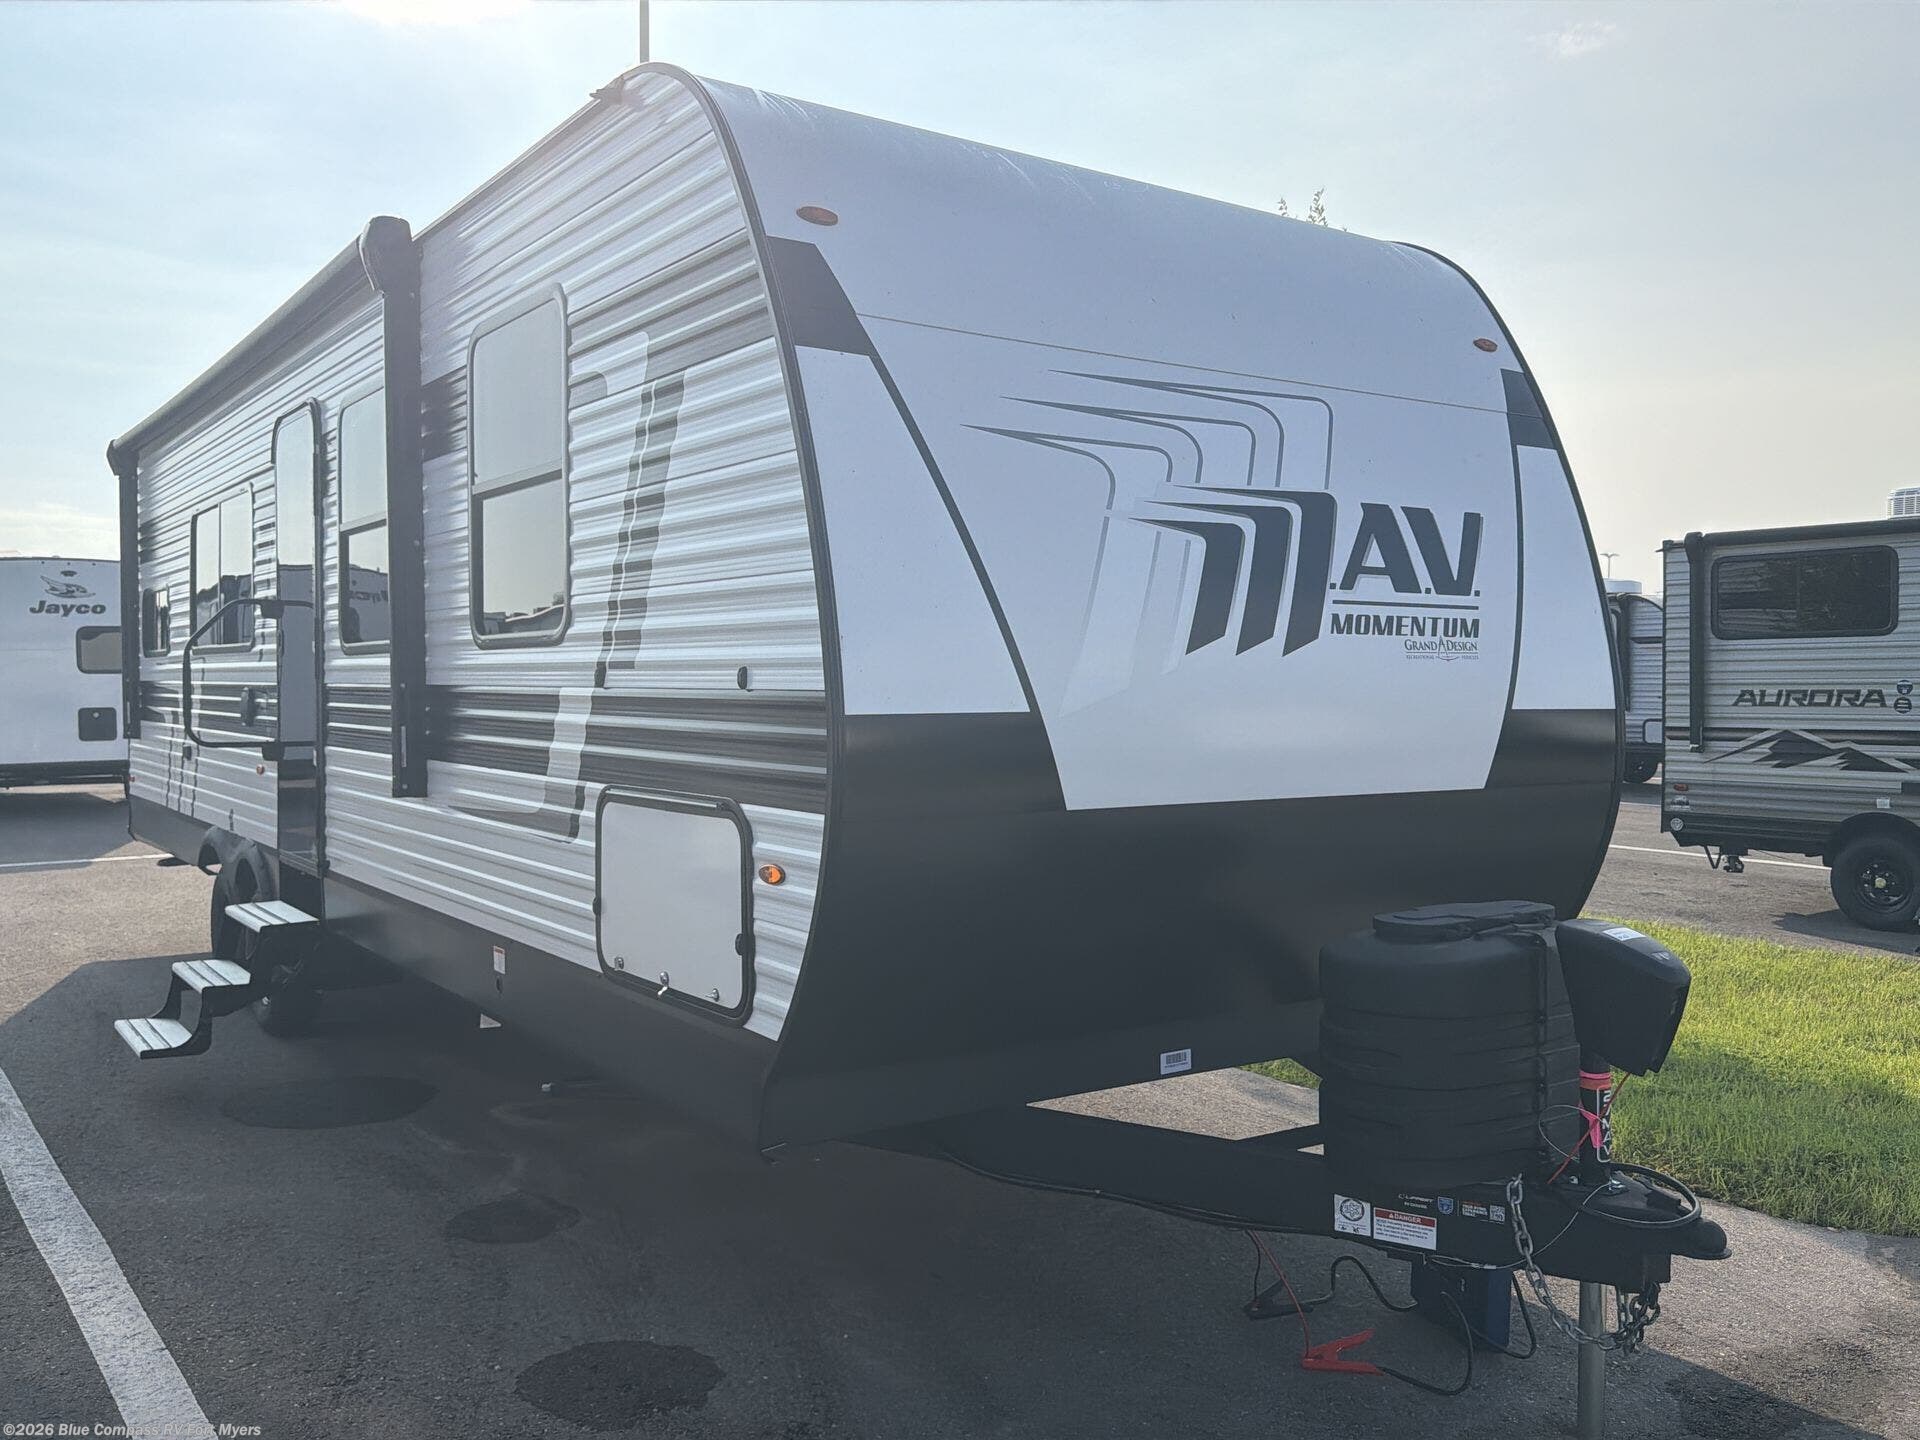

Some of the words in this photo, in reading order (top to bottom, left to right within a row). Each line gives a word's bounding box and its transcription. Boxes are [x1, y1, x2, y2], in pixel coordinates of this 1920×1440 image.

[29, 600, 106, 618] Jayco
[1330, 613, 1480, 639] MOMENTUM
[1732, 689, 1887, 707] AURORA
[1394, 1213, 1422, 1224] DANGER
